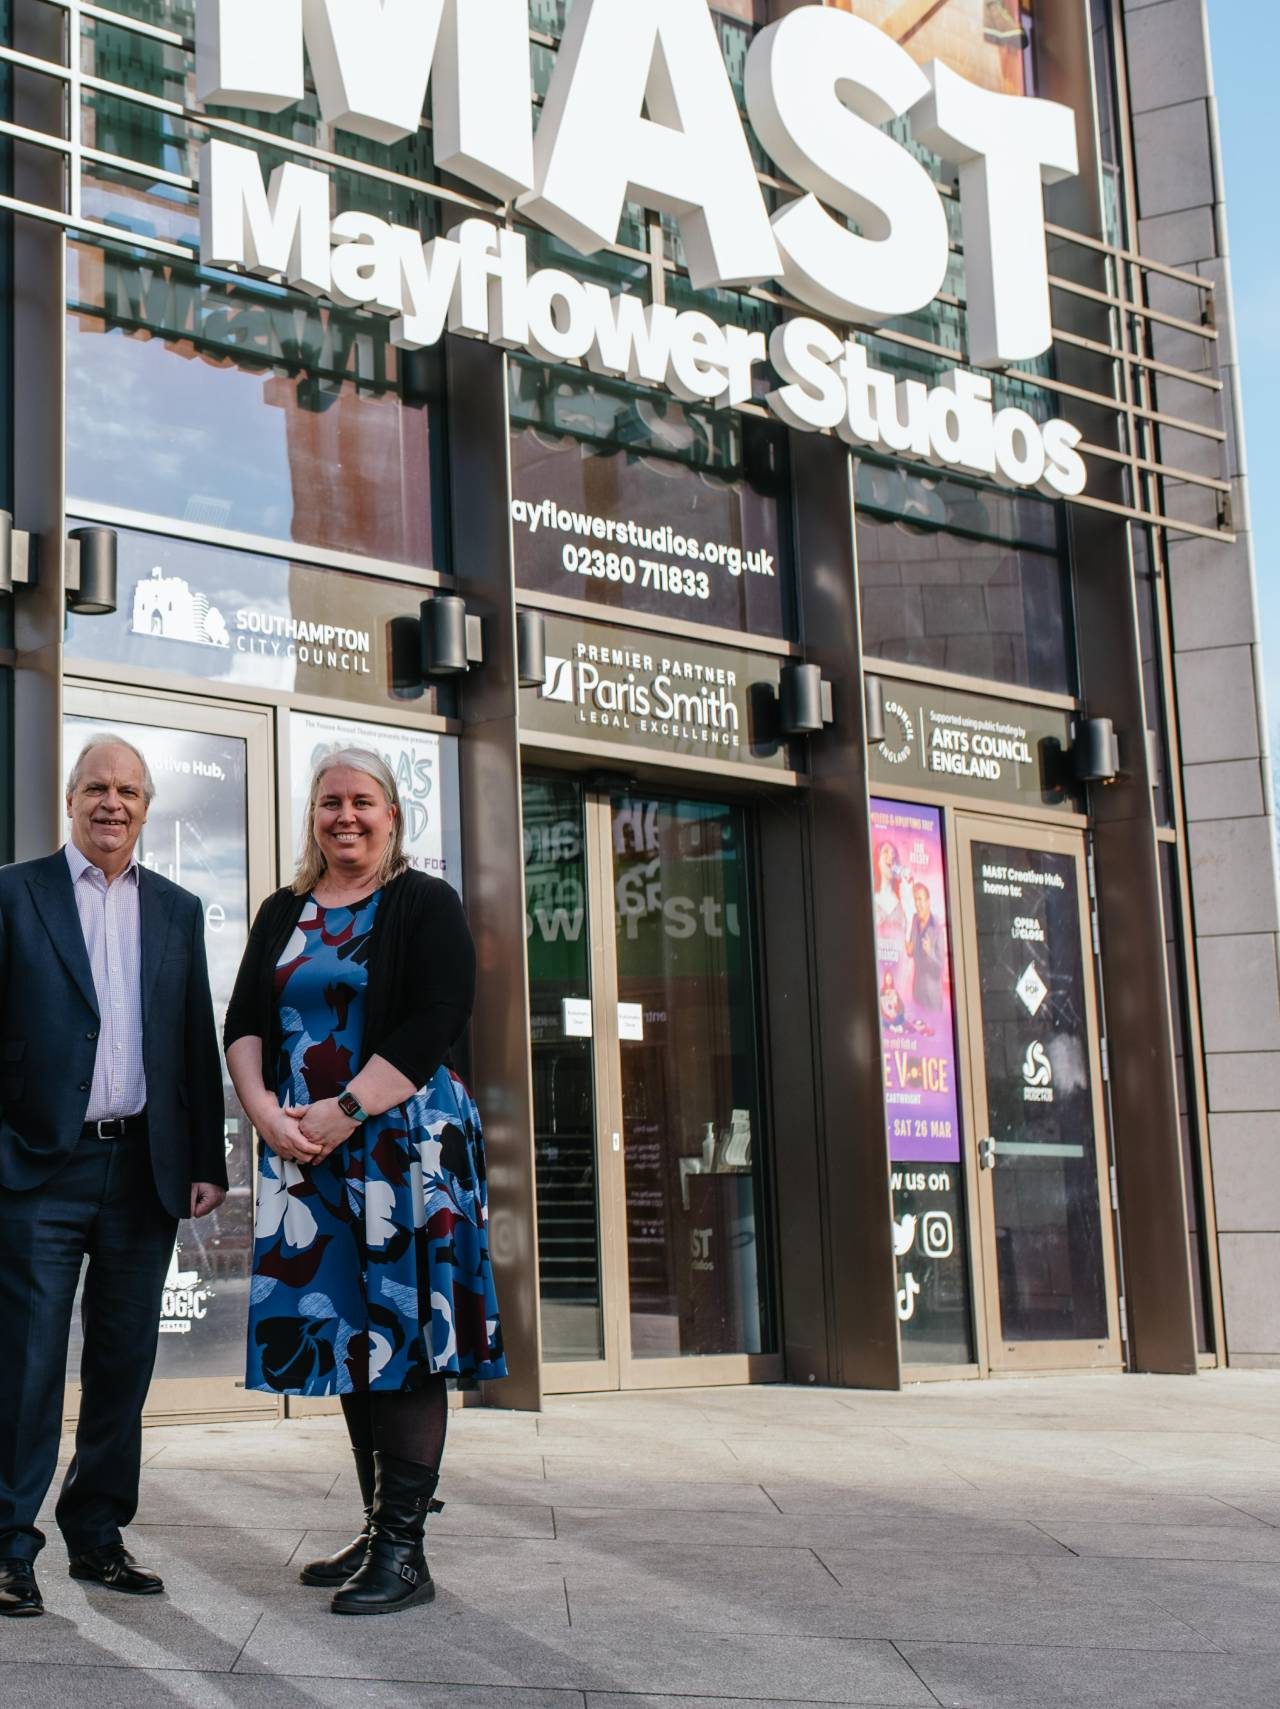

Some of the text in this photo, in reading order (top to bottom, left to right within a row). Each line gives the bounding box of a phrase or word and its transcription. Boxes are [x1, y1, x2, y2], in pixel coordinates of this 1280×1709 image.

[197, 0, 1077, 368] MAST
[200, 138, 765, 404] Mayflower
[771, 318, 1087, 498] Studios
[511, 499, 775, 576] ayflowerstudios.org.uk
[562, 544, 710, 599] 02380 711833
[236, 611, 370, 653] SOUTHAMPTON
[237, 635, 370, 673] CITY COUNCIL
[577, 643, 736, 686] PREMIER PARTNER
[578, 662, 738, 730] Paris Smith
[580, 711, 739, 746] LEGAL EXCELLENCE
[932, 728, 1032, 763] ARTS COUNCIL
[932, 751, 1000, 780] ENGLAND
[982, 865, 1008, 881] MAST
[1008, 869, 1044, 885] Creative
[983, 881, 1010, 896] home
[894, 1118, 911, 1137] SAT
[931, 1120, 952, 1138] MAR
[905, 1173, 926, 1191] us
[928, 1173, 950, 1191] on
